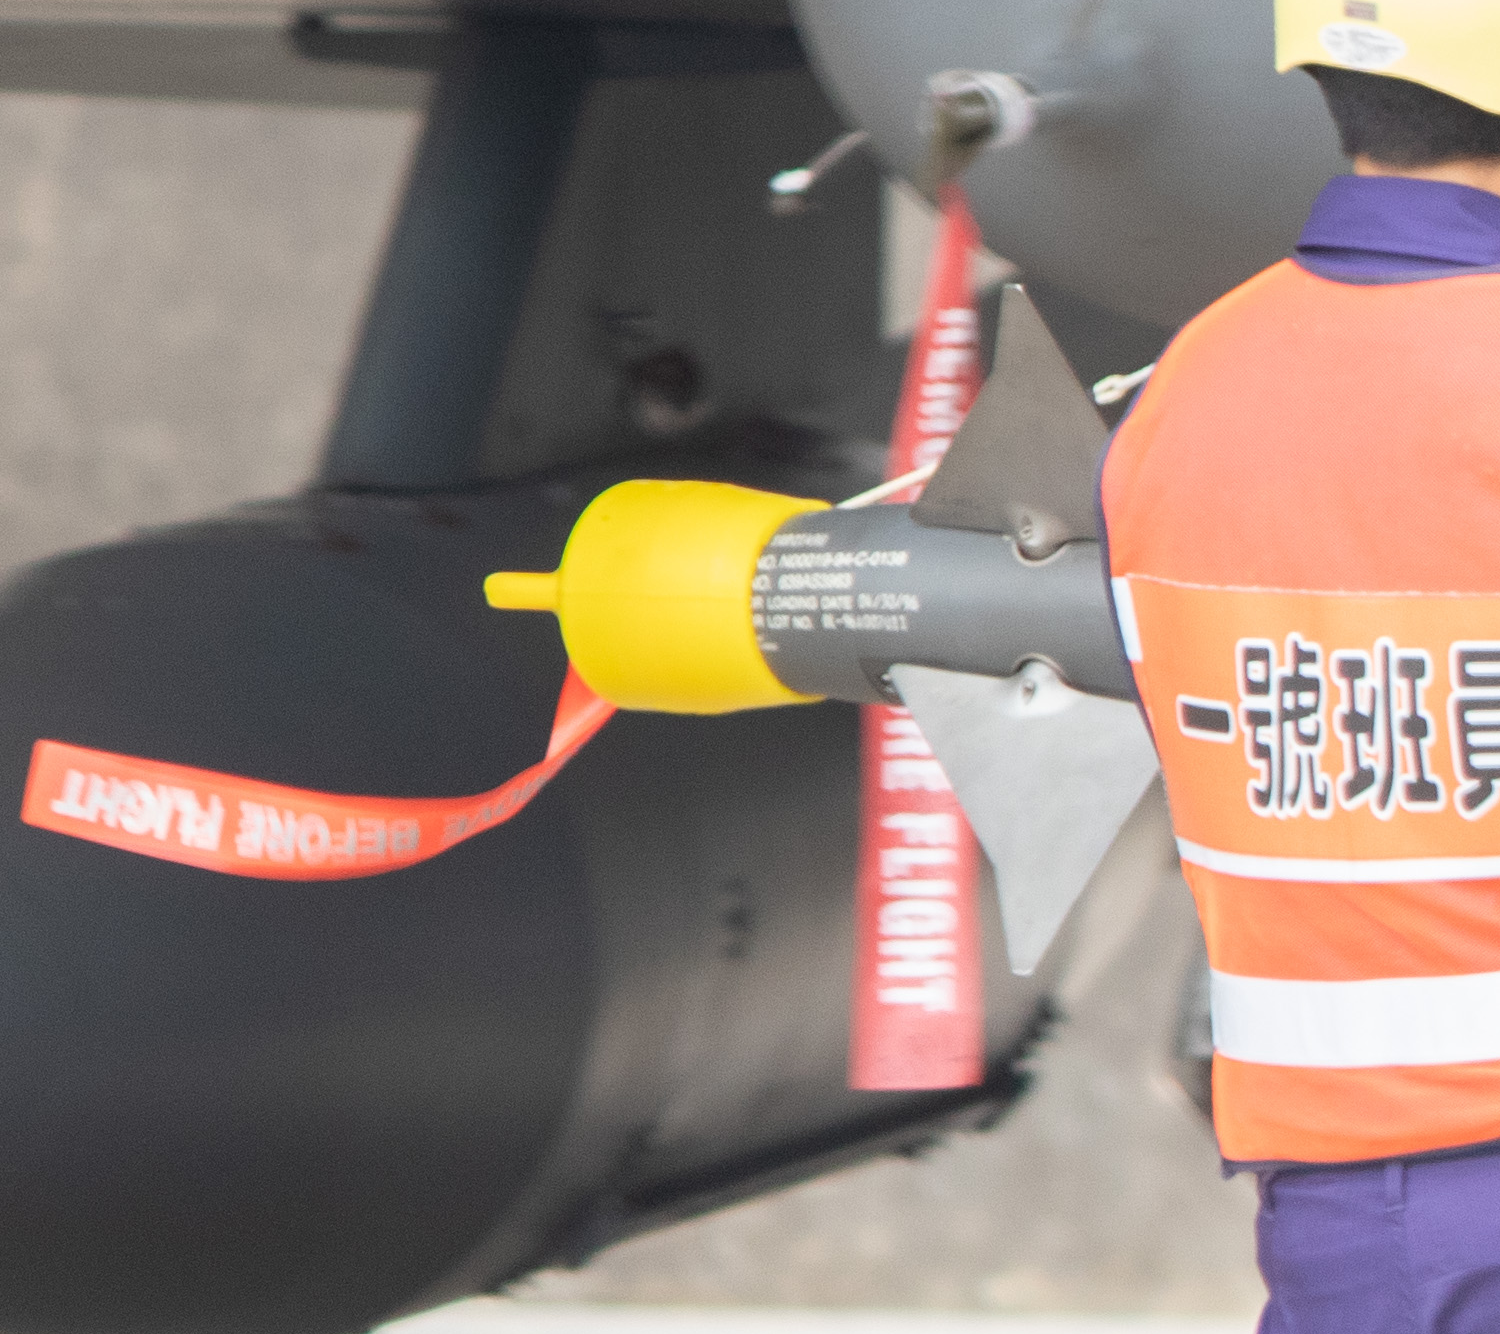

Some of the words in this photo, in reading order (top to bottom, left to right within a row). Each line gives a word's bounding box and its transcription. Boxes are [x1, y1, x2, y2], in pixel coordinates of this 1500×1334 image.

[820, 594, 854, 611] DATE
[51, 768, 226, 854] FLIGHT
[235, 800, 420, 866] BEFORE
[877, 812, 958, 1012] FLIGHT
